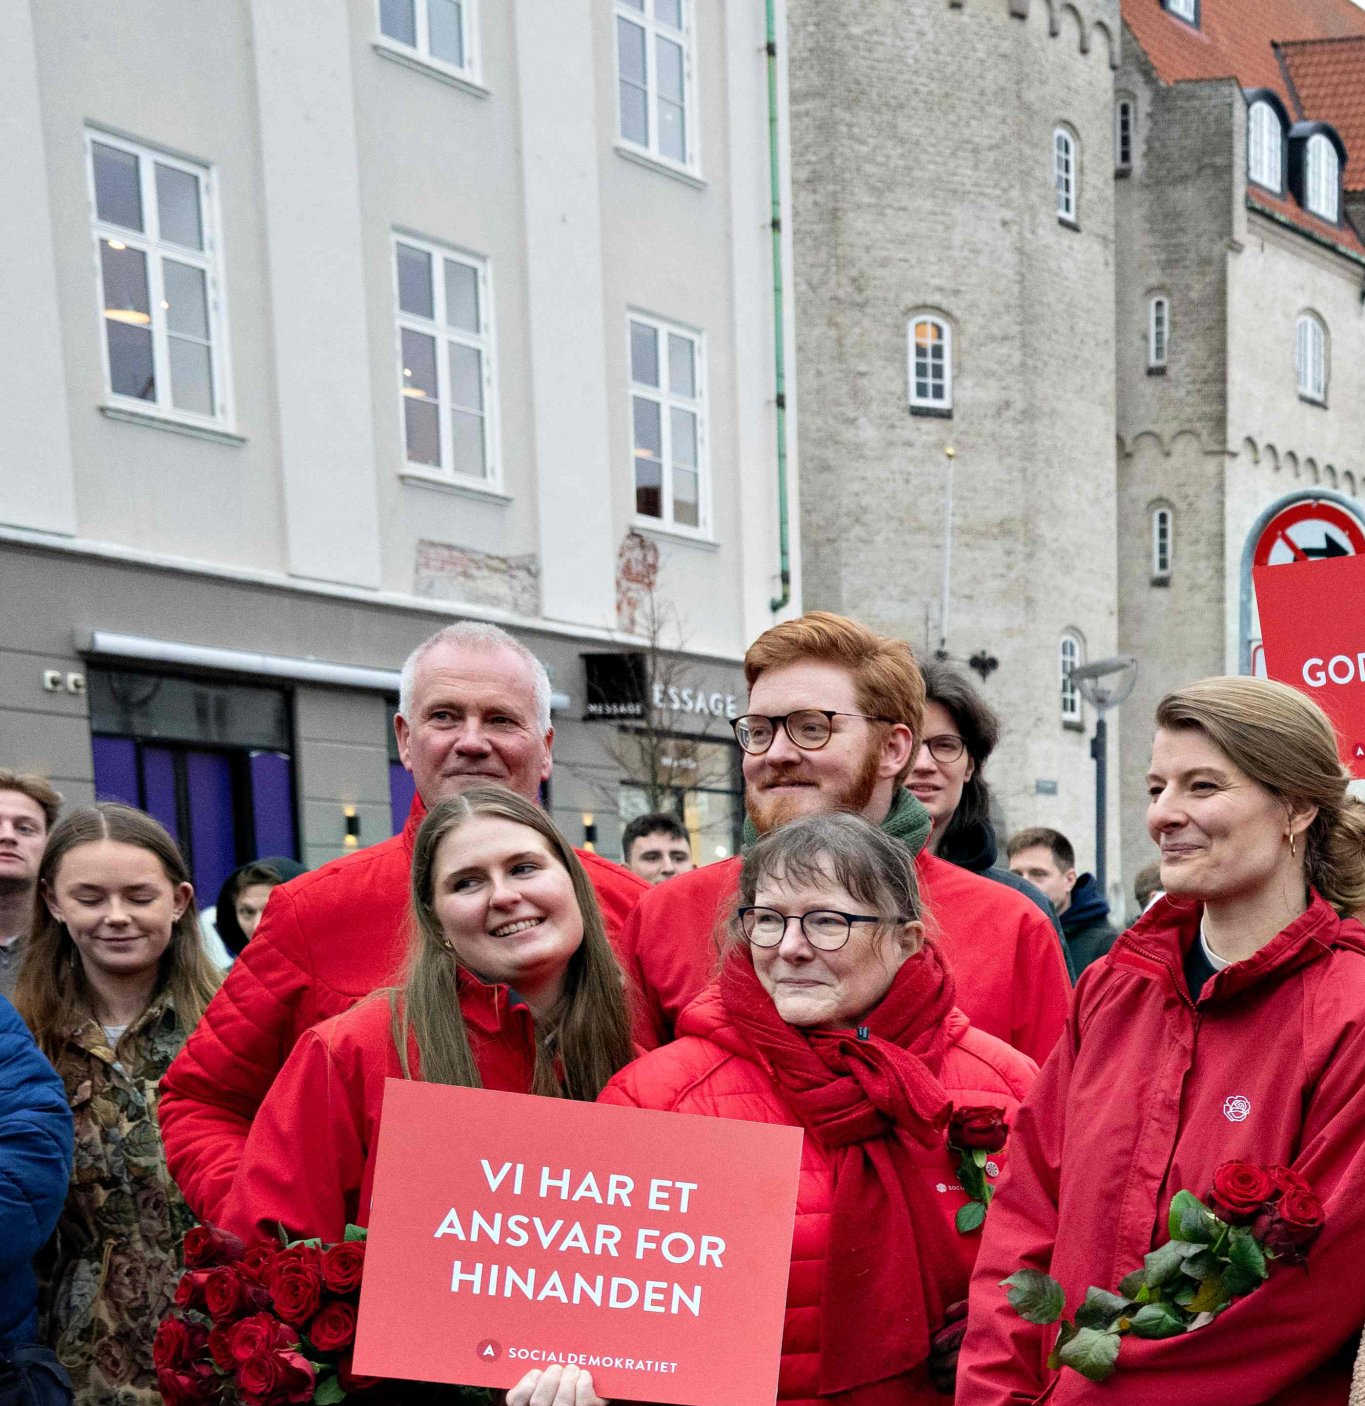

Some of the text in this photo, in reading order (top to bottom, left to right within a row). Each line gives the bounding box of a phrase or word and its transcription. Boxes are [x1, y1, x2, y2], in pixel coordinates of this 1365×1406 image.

[587, 703, 642, 715] MESSAGE
[652, 683, 738, 718] ESSAGE
[480, 1159, 698, 1213] VI HAR ET
[433, 1207, 727, 1268] ANSVAR FOR
[450, 1260, 702, 1317] HINANDEN
[508, 1347, 679, 1374] SOCIALDEMOKRATIET
